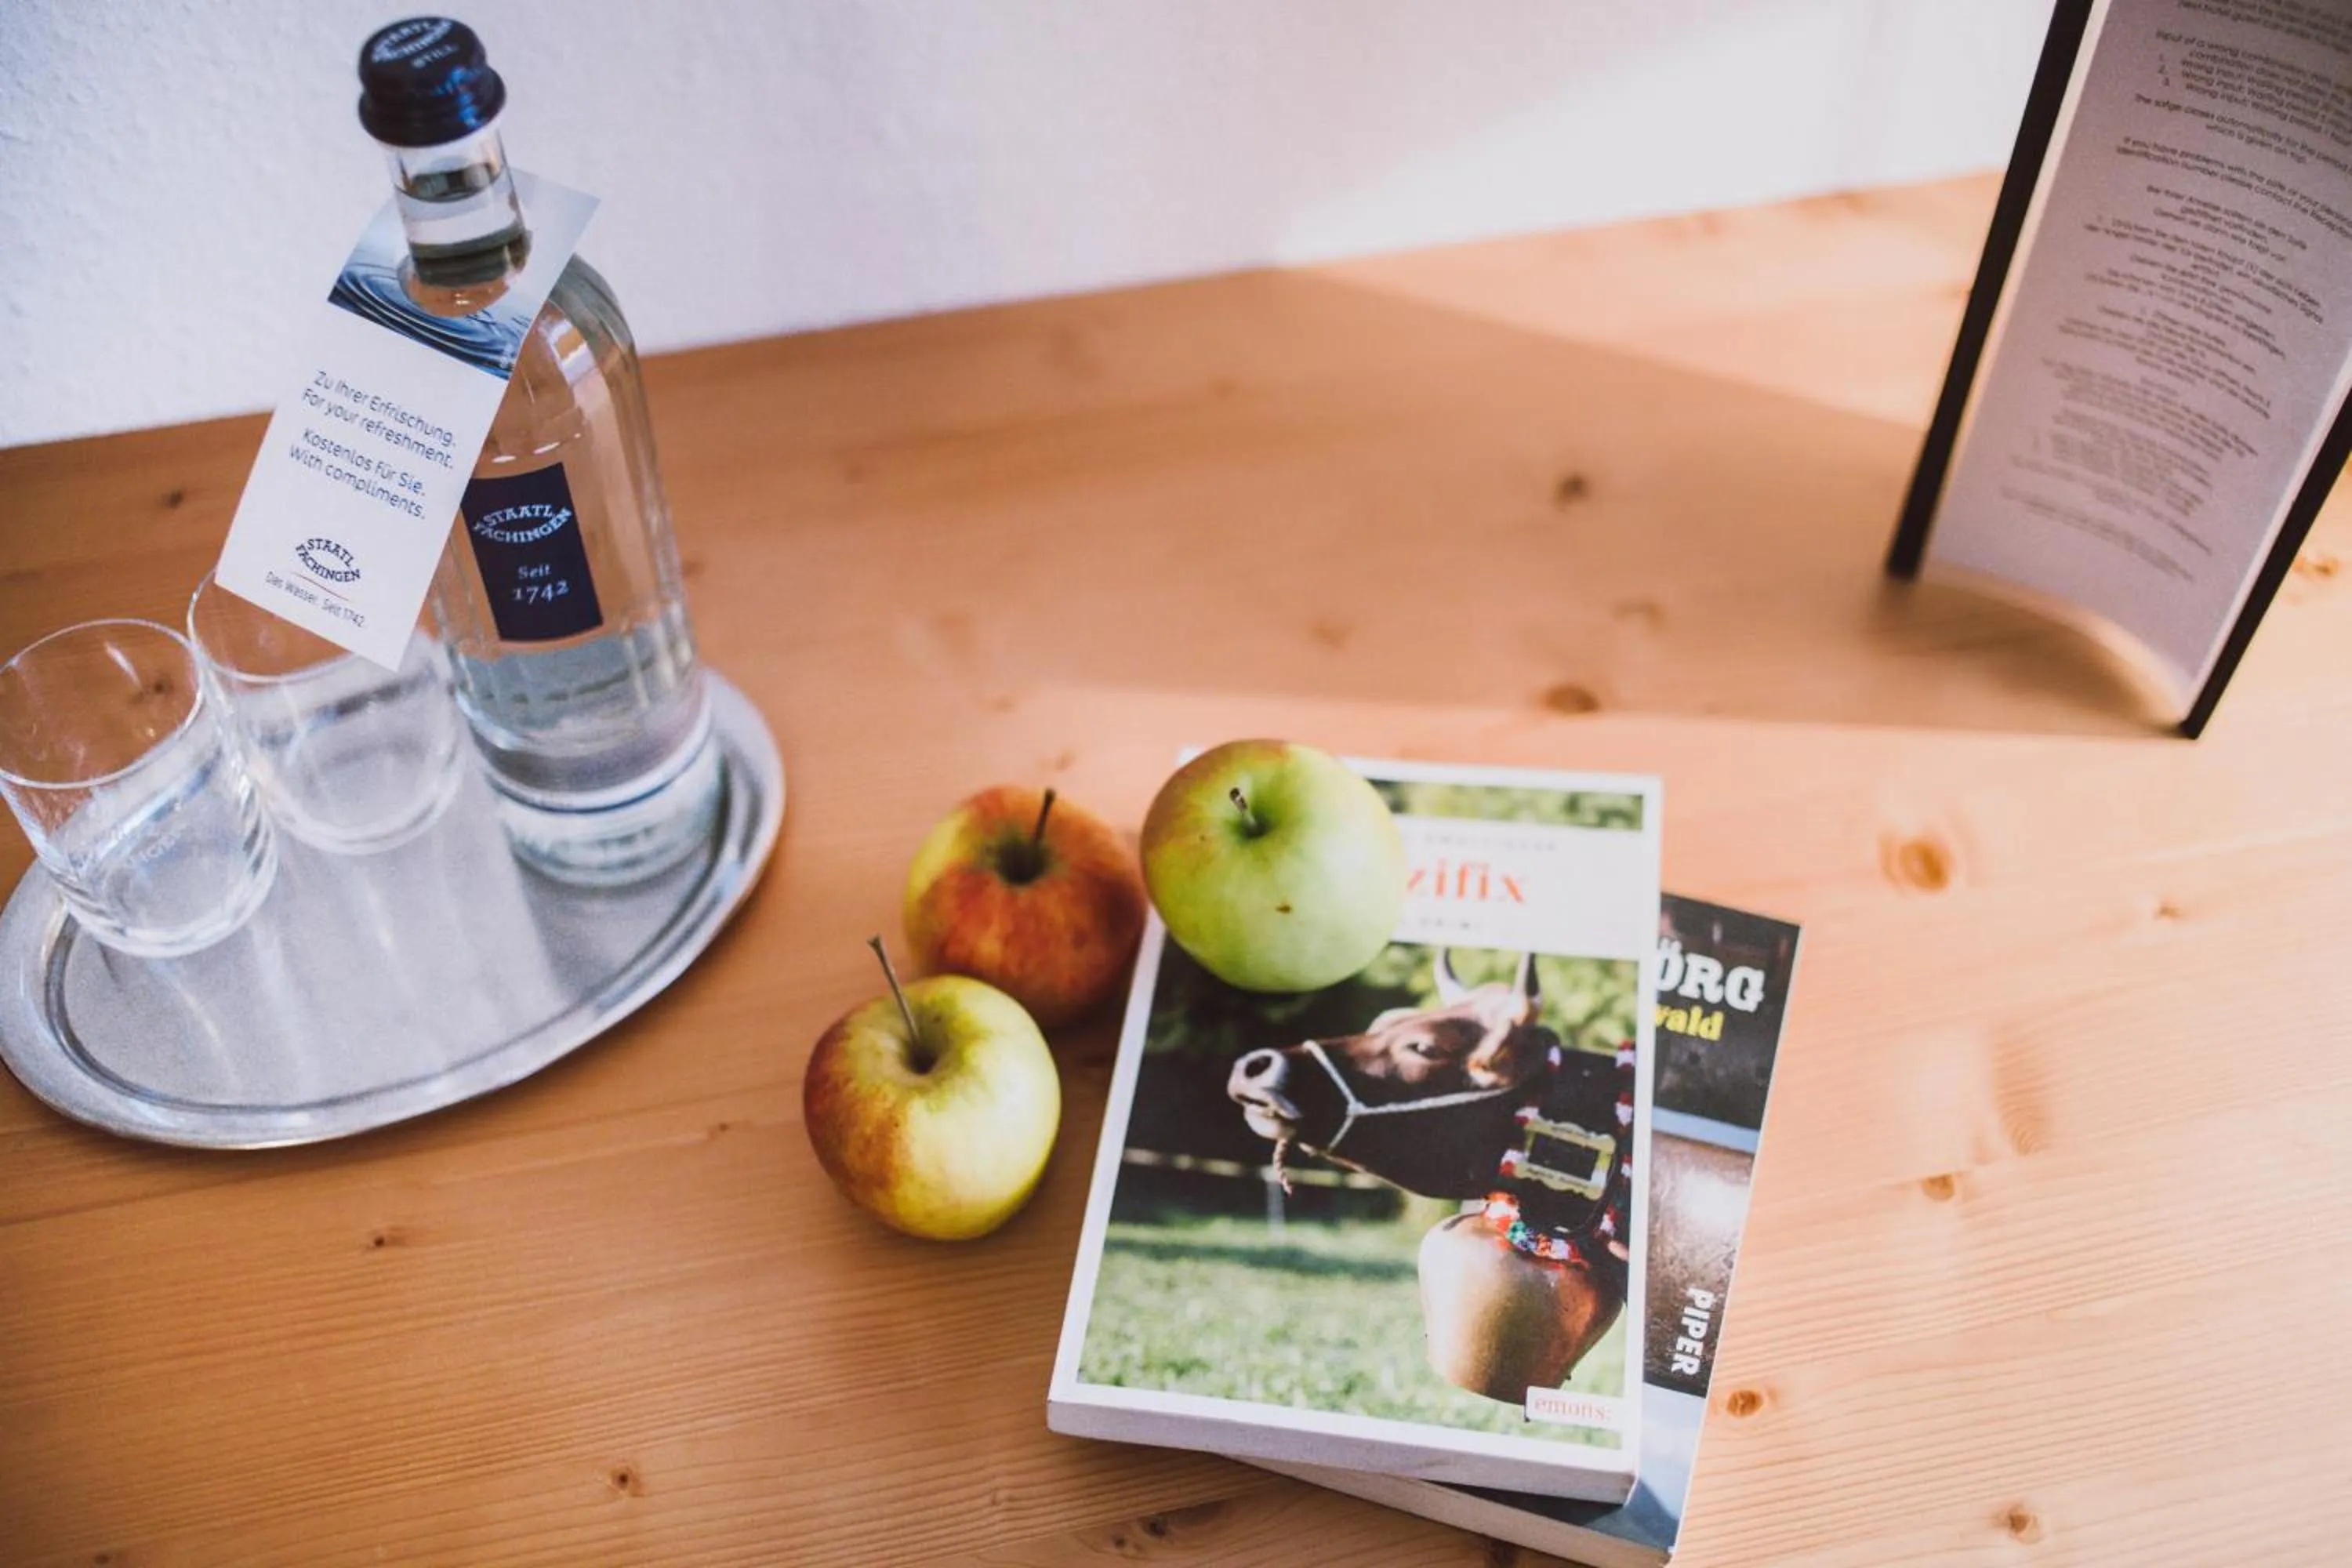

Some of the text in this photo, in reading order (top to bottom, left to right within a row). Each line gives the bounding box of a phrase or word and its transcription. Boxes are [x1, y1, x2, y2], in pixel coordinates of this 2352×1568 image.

[302, 388, 453, 469] For your refreshment.
[314, 370, 456, 448] Zu Ihrer Erfrischung.
[303, 427, 425, 496] Kostenlos für Sie.
[290, 445, 425, 520] With compliments.
[474, 506, 572, 543] FACHINGEN
[296, 543, 361, 582] FACHINGEN
[307, 539, 354, 567] STAATL
[517, 563, 553, 580] Seit
[512, 580, 570, 605] 1742
[343, 608, 365, 628] 1742
[1656, 937, 1766, 1013] ÖRG
[1671, 1286, 1716, 1377] PIPER
[1534, 1398, 1611, 1421] emons:
